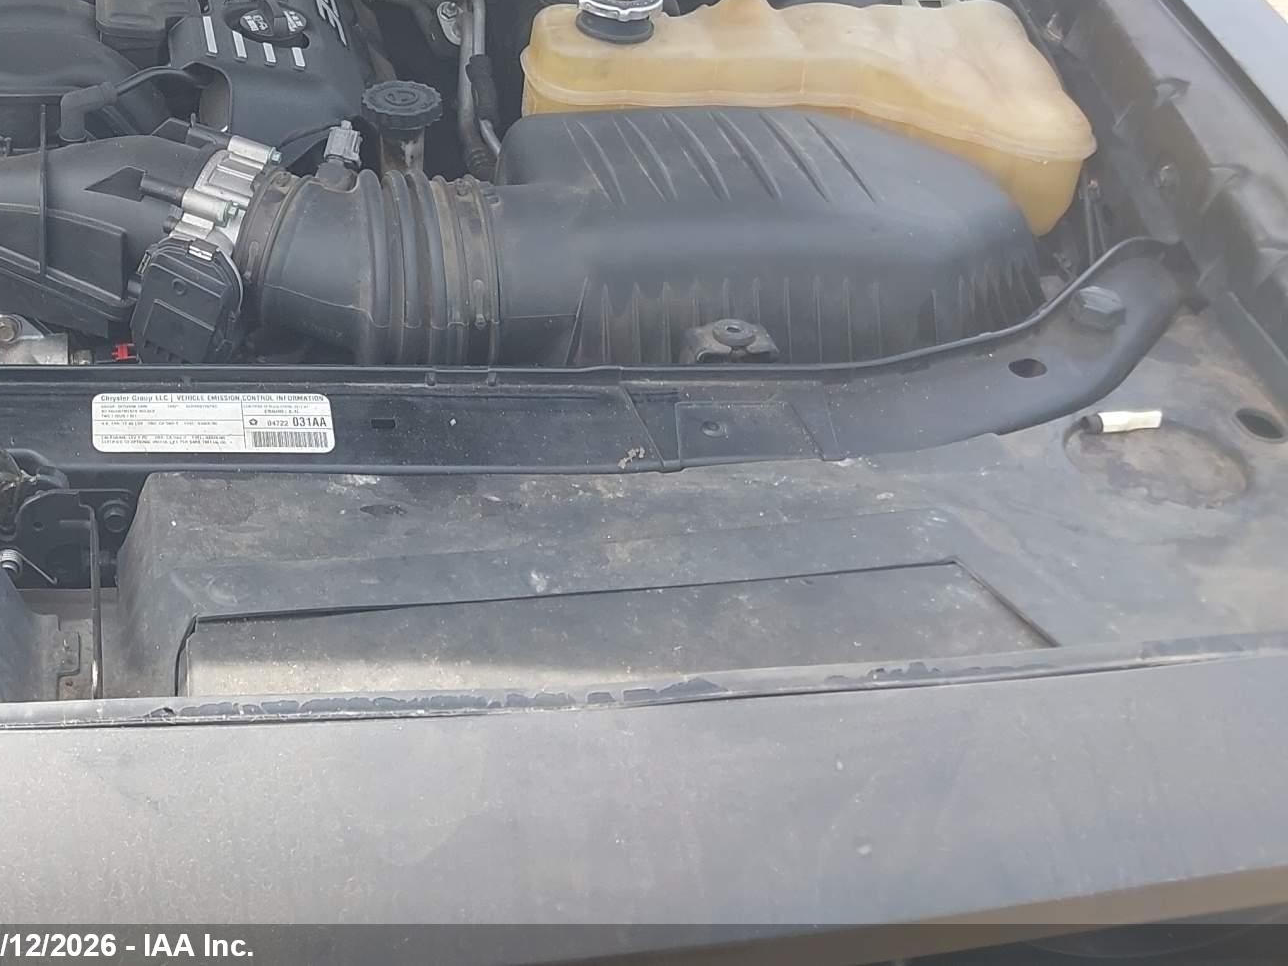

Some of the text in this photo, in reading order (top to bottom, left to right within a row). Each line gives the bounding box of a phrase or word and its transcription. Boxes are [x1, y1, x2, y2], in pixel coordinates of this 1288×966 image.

[100, 395, 129, 403] Chrysler
[131, 395, 153, 403] Group
[292, 417, 327, 427] 031AA
